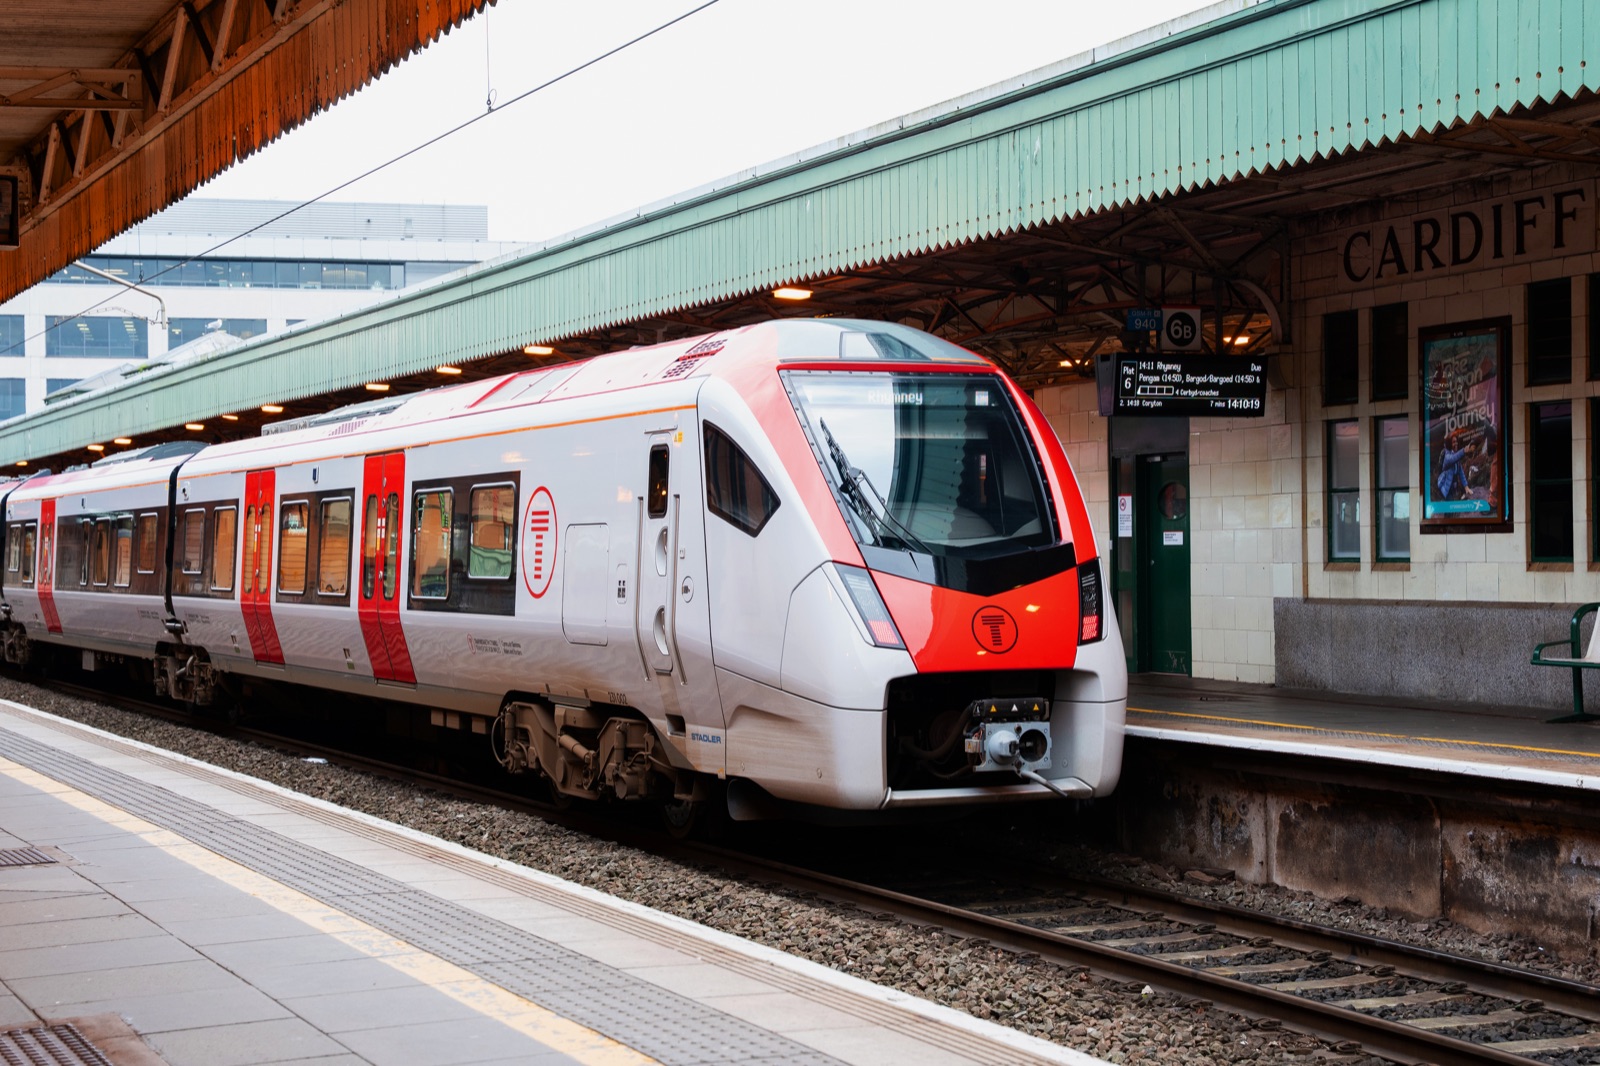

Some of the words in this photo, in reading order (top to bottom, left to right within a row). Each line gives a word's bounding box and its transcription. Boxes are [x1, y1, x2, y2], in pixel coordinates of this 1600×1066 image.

[1343, 188, 1586, 283] CARDIFF
[1134, 318, 1156, 329] 940
[1170, 318, 1192, 340] 6B
[1123, 366, 1135, 375] Plat
[1139, 361, 1154, 370] 14:11
[1156, 361, 1181, 372] Rhymney
[1250, 363, 1262, 372] Due
[1124, 377, 1132, 390] 6
[1138, 373, 1160, 384] Pengam
[867, 390, 923, 406] Rhymney
[1141, 400, 1163, 408] Coryton
[1227, 399, 1261, 409] 14:10:19
[1446, 385, 1479, 417] your
[1439, 402, 1495, 439] Journey
[691, 732, 722, 745] STADLER
